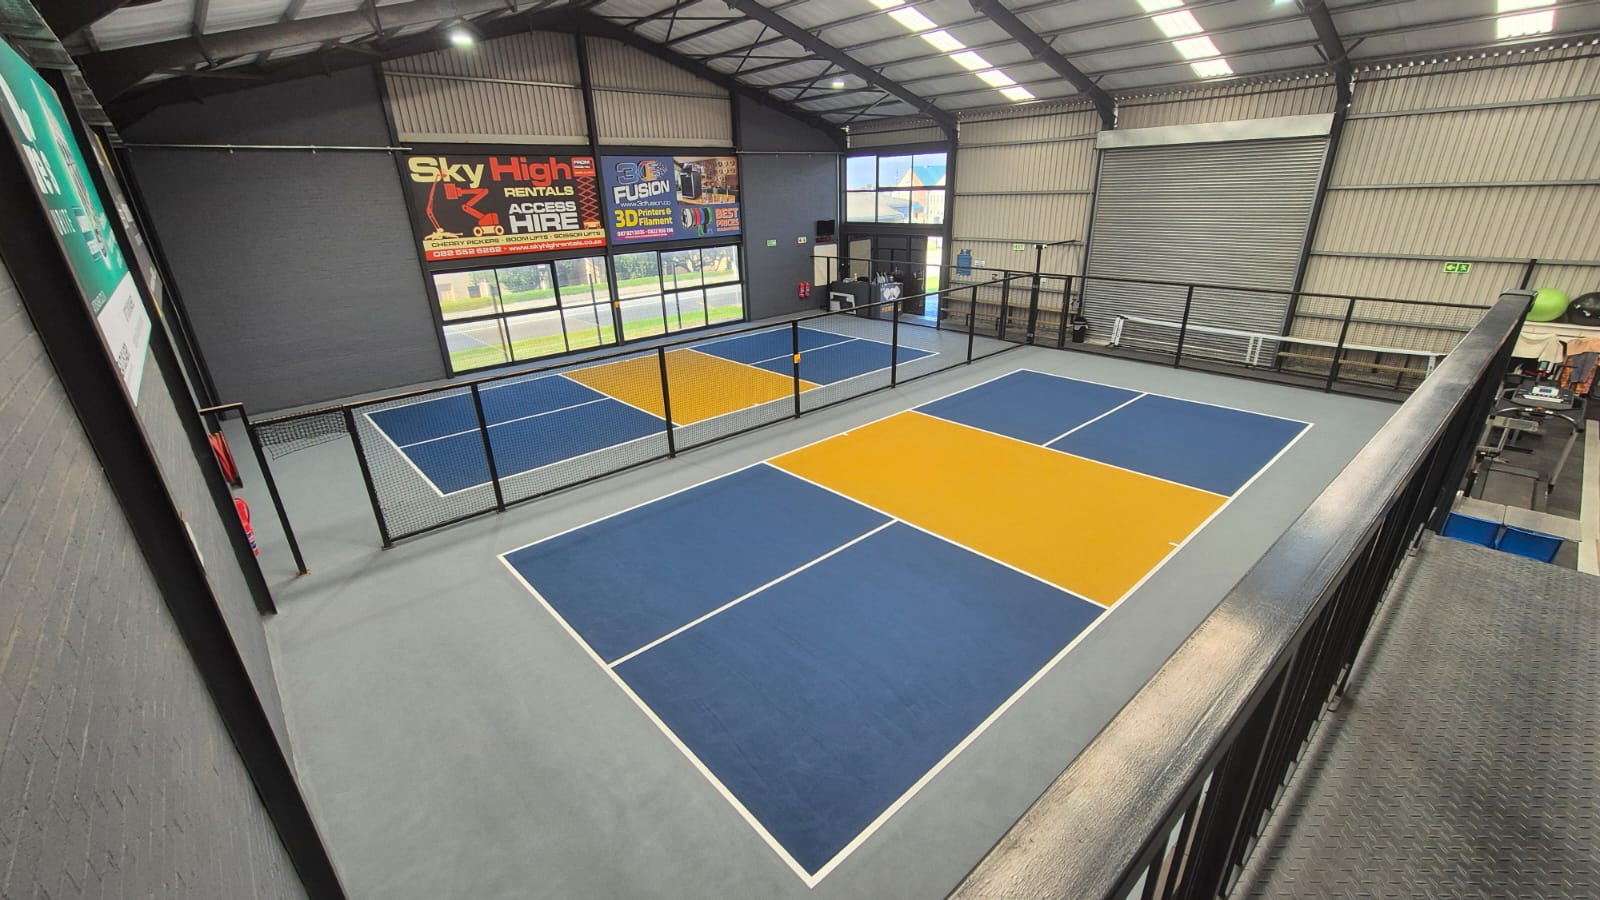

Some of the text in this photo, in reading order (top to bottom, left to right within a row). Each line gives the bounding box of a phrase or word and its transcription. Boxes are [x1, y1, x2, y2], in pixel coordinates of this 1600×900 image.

[408, 156, 572, 188] Sky High
[504, 186, 574, 198] RENTALS
[613, 179, 670, 204] FUSION
[509, 201, 577, 214] ACCESS
[715, 207, 739, 219] BEST
[509, 212, 580, 234] HIRE
[615, 209, 639, 228] 3D
[638, 208, 666, 217] Printers
[638, 216, 673, 226] Filament
[431, 239, 465, 248] CHERRY
